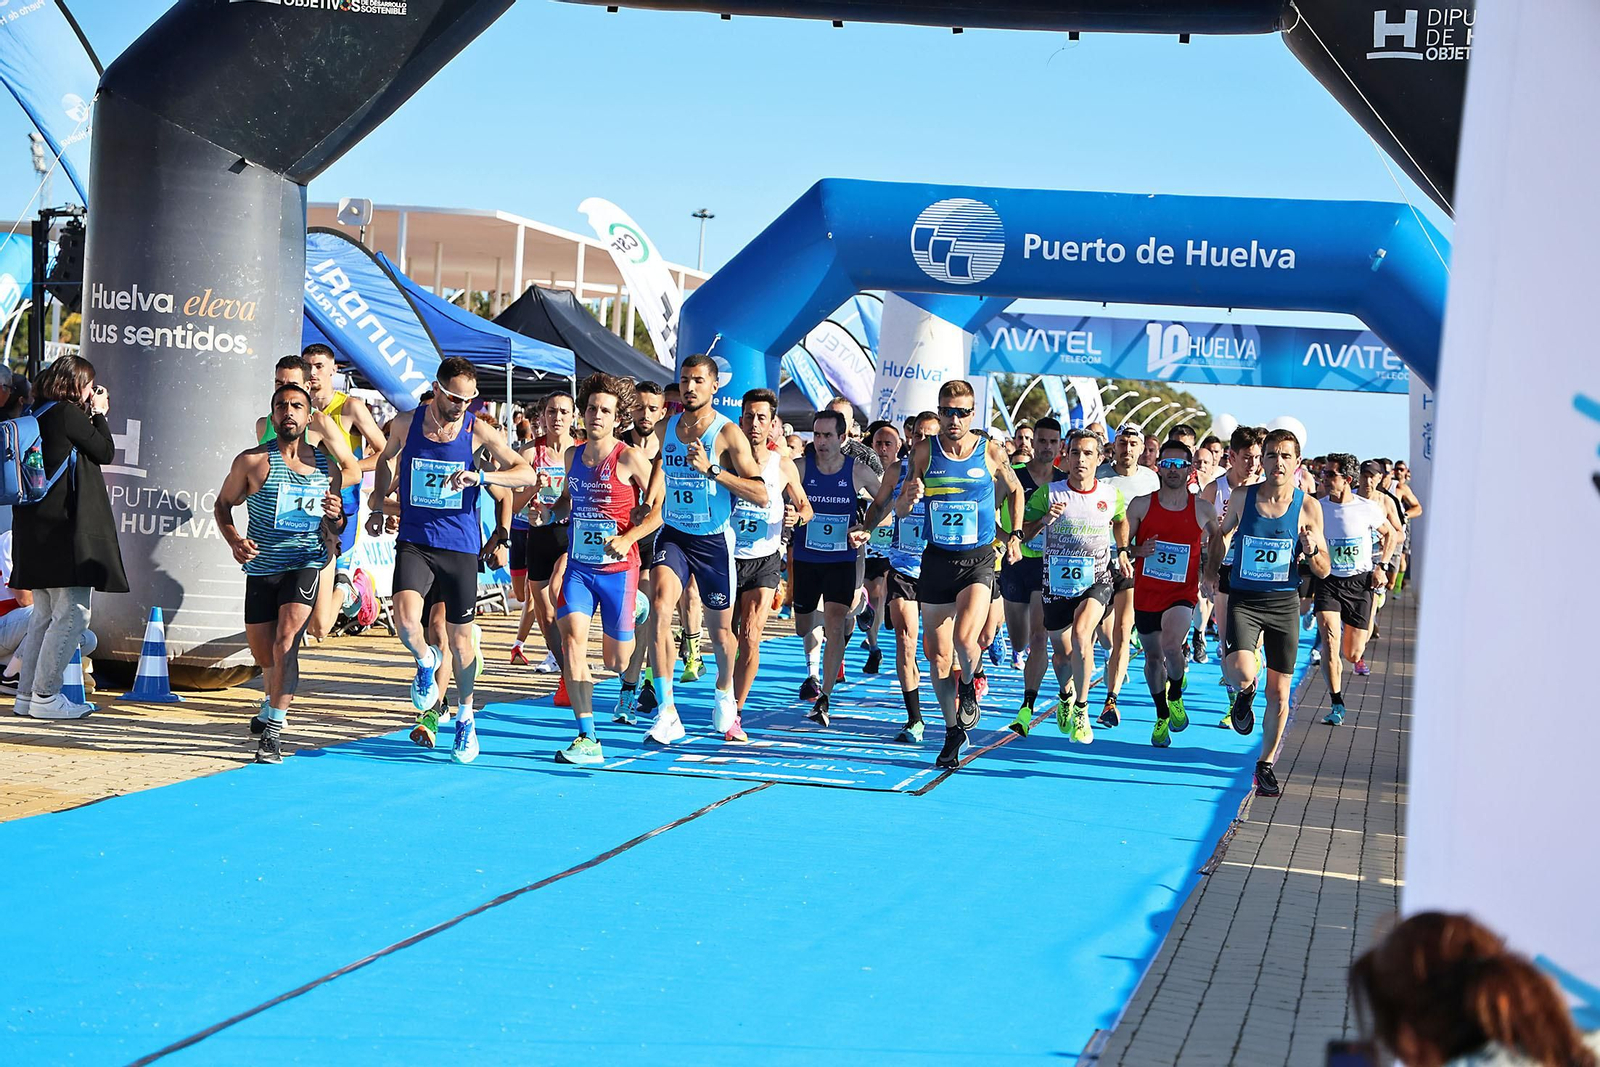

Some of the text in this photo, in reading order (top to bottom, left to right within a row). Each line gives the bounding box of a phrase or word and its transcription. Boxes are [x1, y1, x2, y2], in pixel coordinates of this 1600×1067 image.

[360, 6, 407, 15] SOSTENIBLE
[1427, 8, 1476, 26] DIPU
[1426, 29, 1455, 46] DE
[1425, 47, 1474, 60] OBJET
[1023, 233, 1296, 269] Puerto de Huelva
[91, 283, 256, 321] Huelva eleva
[90, 319, 254, 355] tus sentidos.
[991, 327, 1102, 355] AVATEL
[1188, 336, 1257, 360] HUELVA
[1060, 355, 1102, 364] TELECOM
[1302, 343, 1409, 370] AVATE
[882, 361, 942, 382] Huelva
[1376, 371, 1409, 380] TELEC
[722, 397, 743, 407] Hue
[425, 473, 448, 488] 27
[106, 485, 217, 513] PUTACIÓ
[674, 490, 694, 503] 18
[808, 495, 850, 504] ROTASIERRA
[294, 497, 315, 511] 14
[942, 513, 964, 526] 22
[121, 513, 221, 540] HUELVA
[738, 520, 758, 533] 15
[823, 525, 833, 535] 9
[584, 532, 603, 544] 25
[1254, 549, 1278, 563] 20
[1335, 546, 1359, 557] 145
[1157, 552, 1177, 565] 35
[1061, 567, 1081, 579] 26
